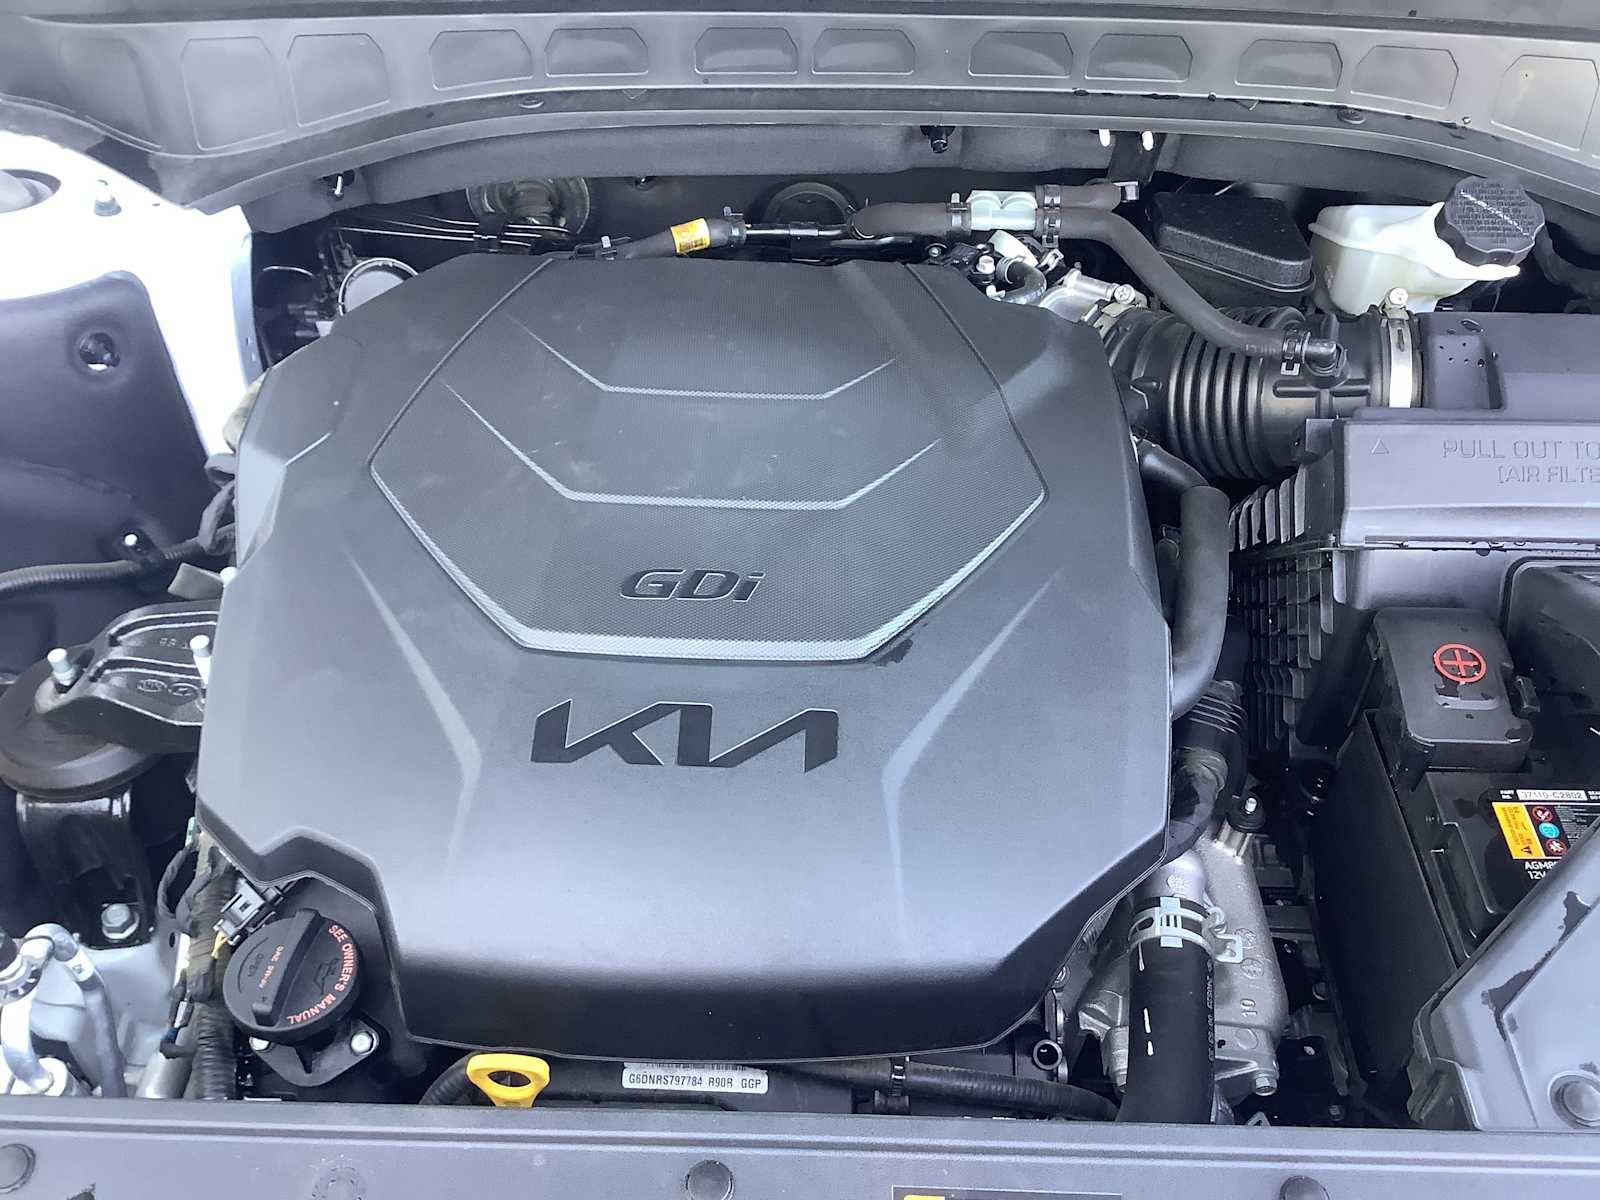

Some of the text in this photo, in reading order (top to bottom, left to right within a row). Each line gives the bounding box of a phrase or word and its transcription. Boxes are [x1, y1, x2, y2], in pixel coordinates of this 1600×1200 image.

[1442, 439, 1505, 459] PULL
[1513, 439, 1562, 460] OUT
[620, 569, 766, 602] GDi
[287, 925, 357, 1025] SEE OWNER'S MANUAL
